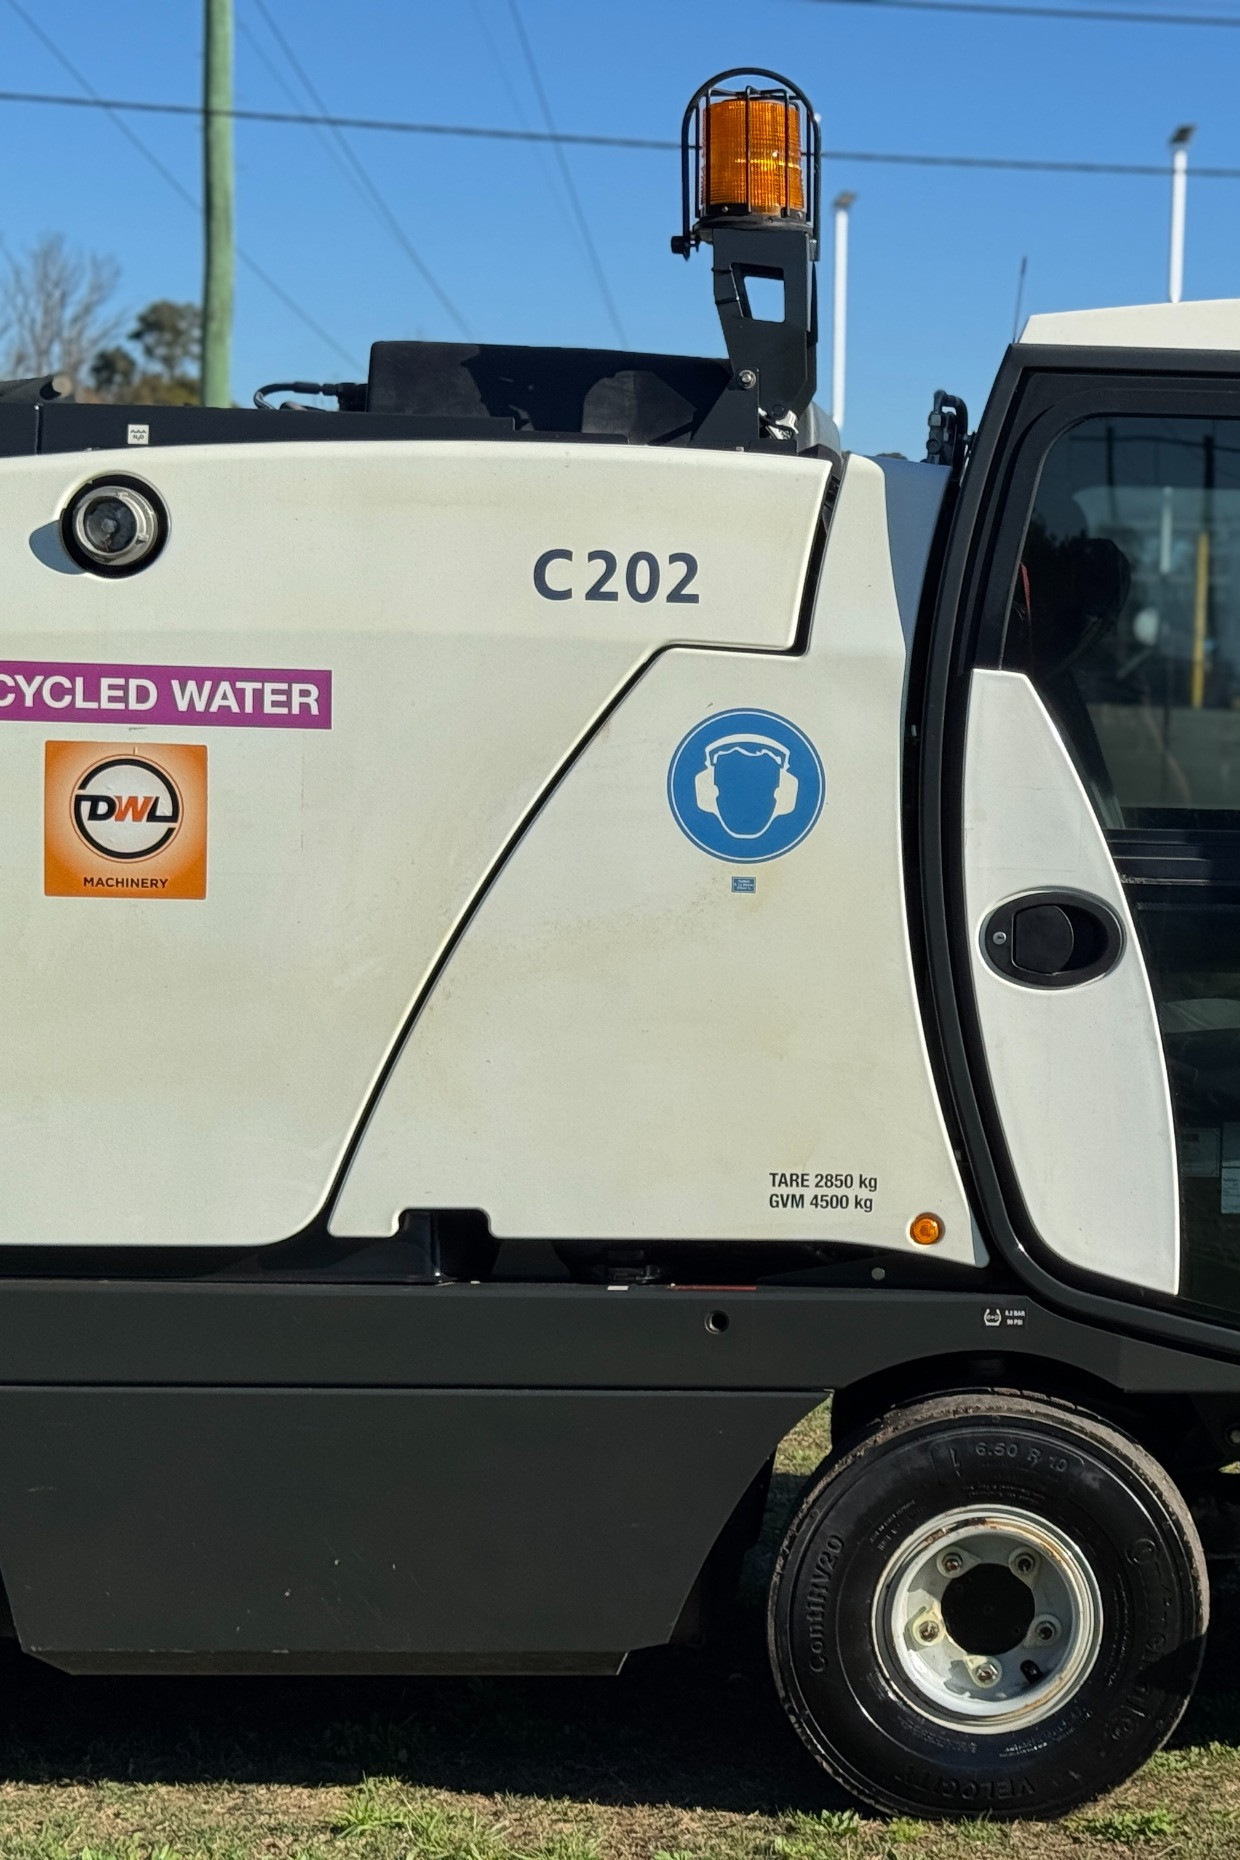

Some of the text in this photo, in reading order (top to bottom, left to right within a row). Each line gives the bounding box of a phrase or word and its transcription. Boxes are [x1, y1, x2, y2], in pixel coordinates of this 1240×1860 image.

[533, 548, 700, 604] C202
[171, 678, 320, 716] WATER
[74, 794, 179, 823] DWL
[83, 876, 168, 889] MACHINERY
[768, 1172, 878, 1192] TARE 2850 kg
[769, 1193, 873, 1213] GVM 4500 kg
[974, 1441, 1019, 1459] 6.50
[808, 1533, 846, 1675] ContiRV20
